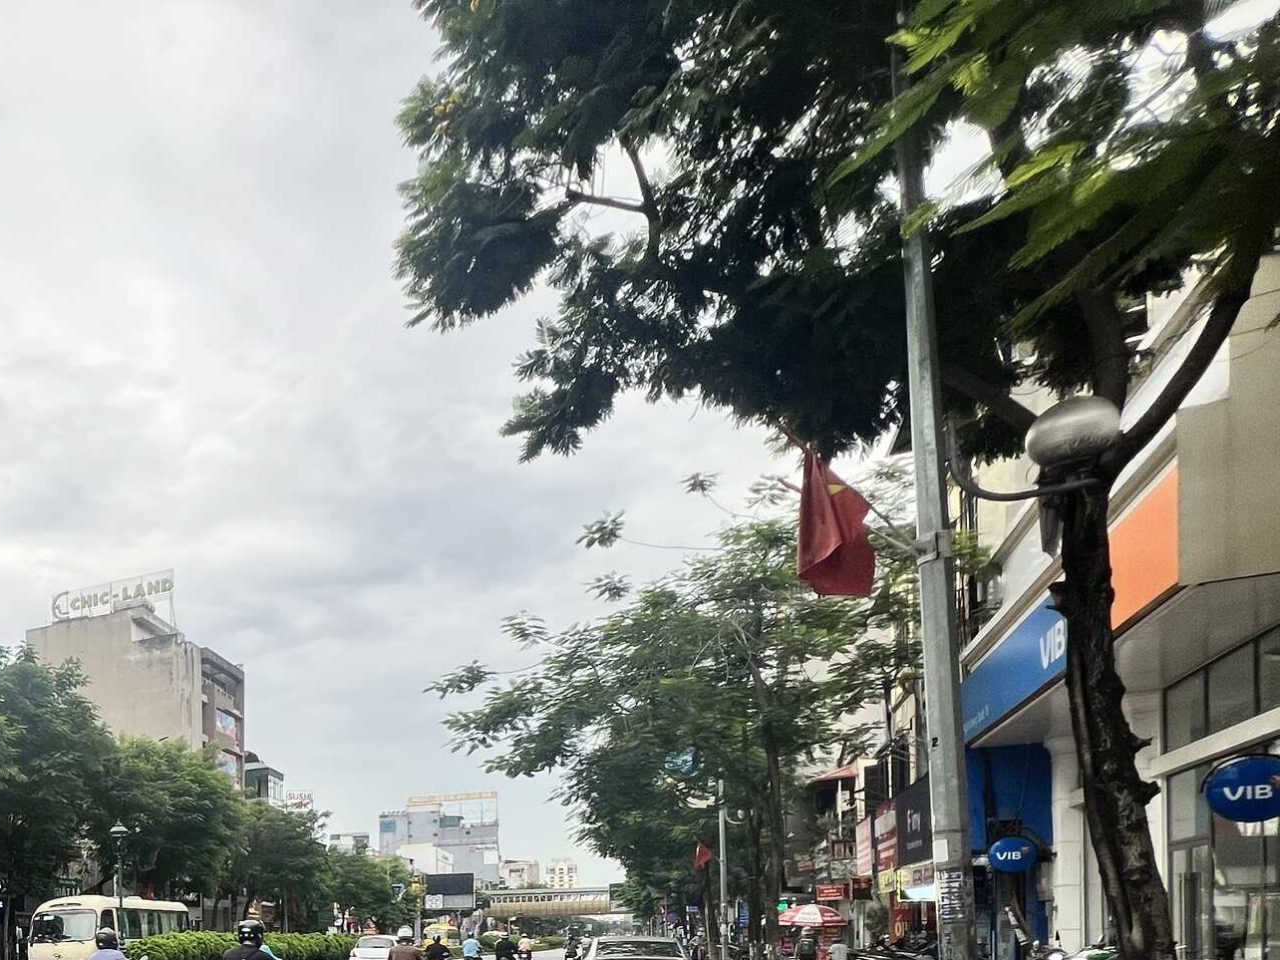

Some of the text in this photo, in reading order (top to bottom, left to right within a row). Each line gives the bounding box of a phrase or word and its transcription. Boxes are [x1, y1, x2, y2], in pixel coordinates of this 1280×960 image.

[1039, 619, 1066, 670] VIB
[1223, 784, 1273, 801] VIB
[995, 851, 1022, 861] VIB
